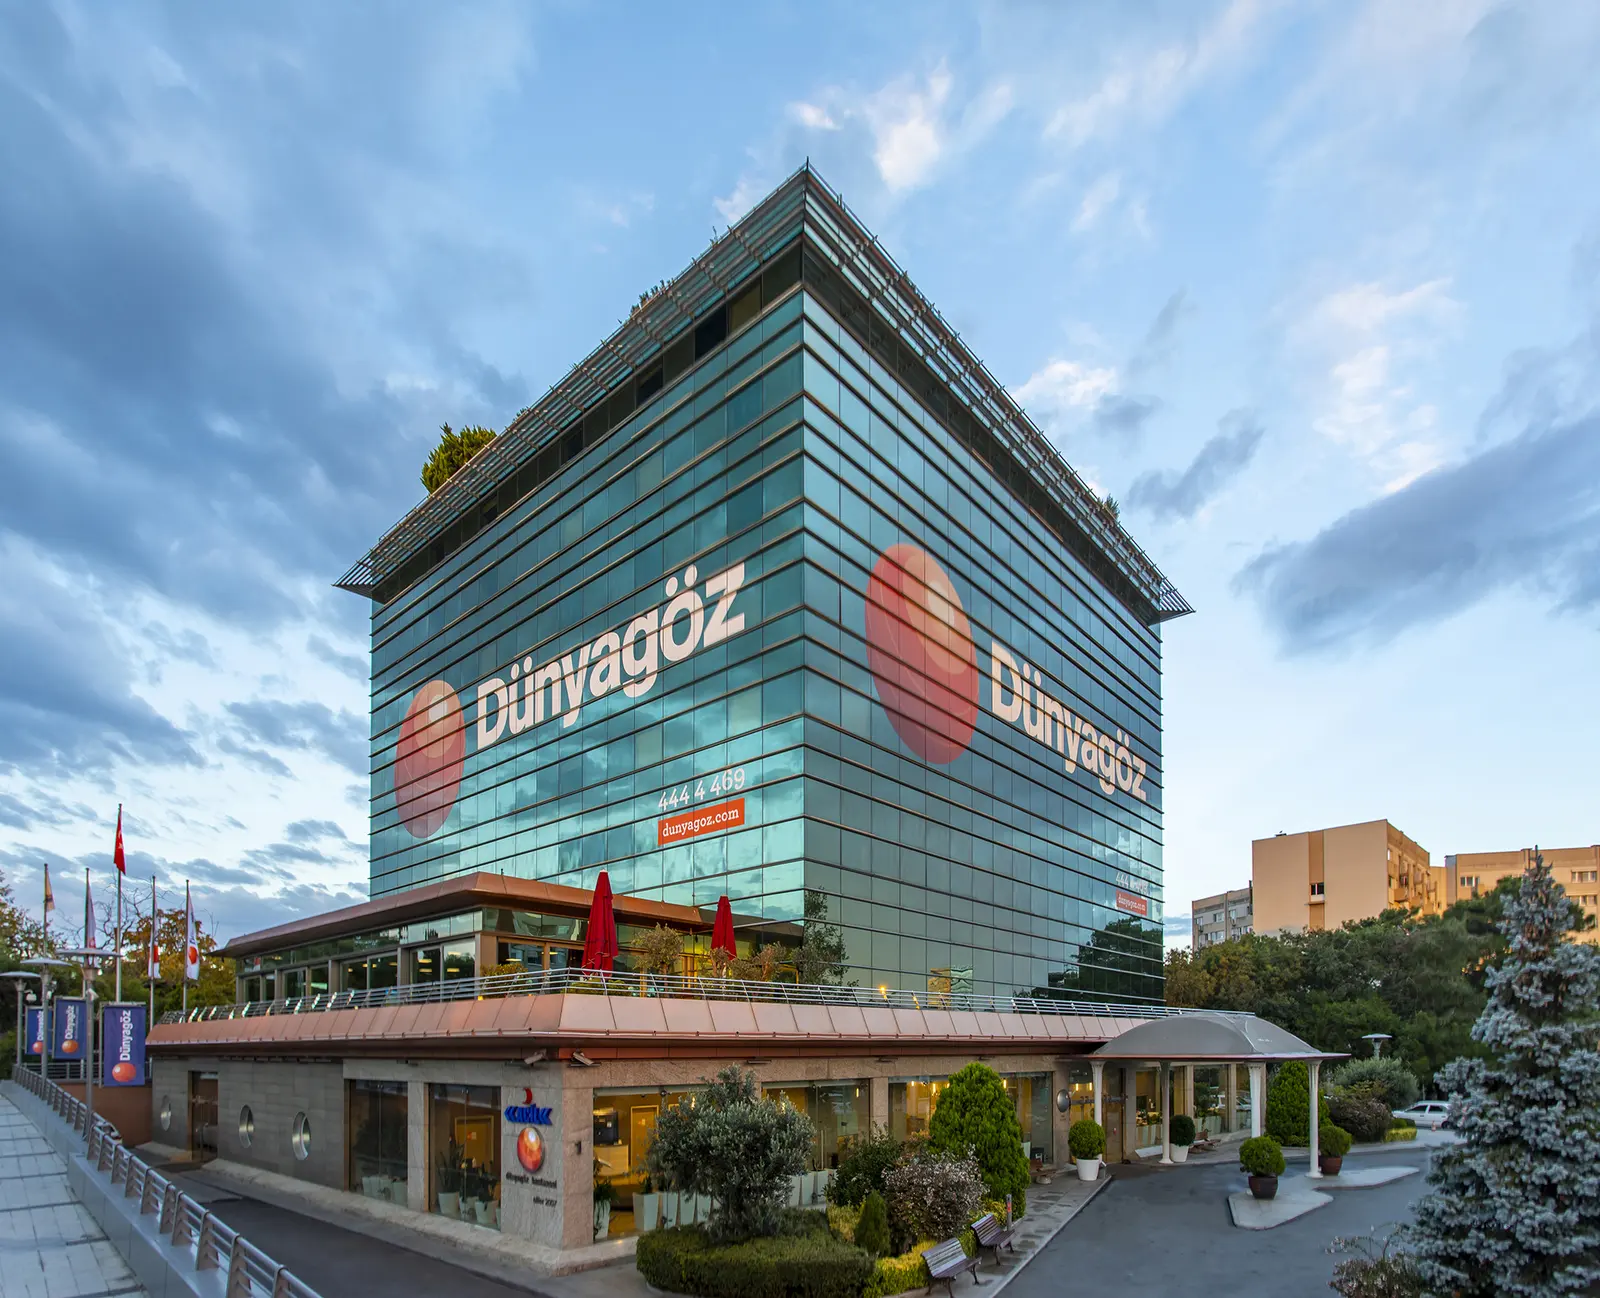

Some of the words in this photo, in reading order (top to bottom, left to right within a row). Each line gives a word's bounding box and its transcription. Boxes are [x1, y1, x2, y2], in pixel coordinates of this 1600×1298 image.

[477, 562, 745, 750] Dünyagöz
[991, 640, 1147, 801] Dünyagöz
[658, 784, 690, 811] 444
[694, 780, 705, 800] 4
[710, 767, 745, 796] 469
[662, 808, 739, 836] dunyagoz.com
[65, 1005, 76, 1039] Dünyagöz
[119, 1009, 133, 1061] Dünyagöz
